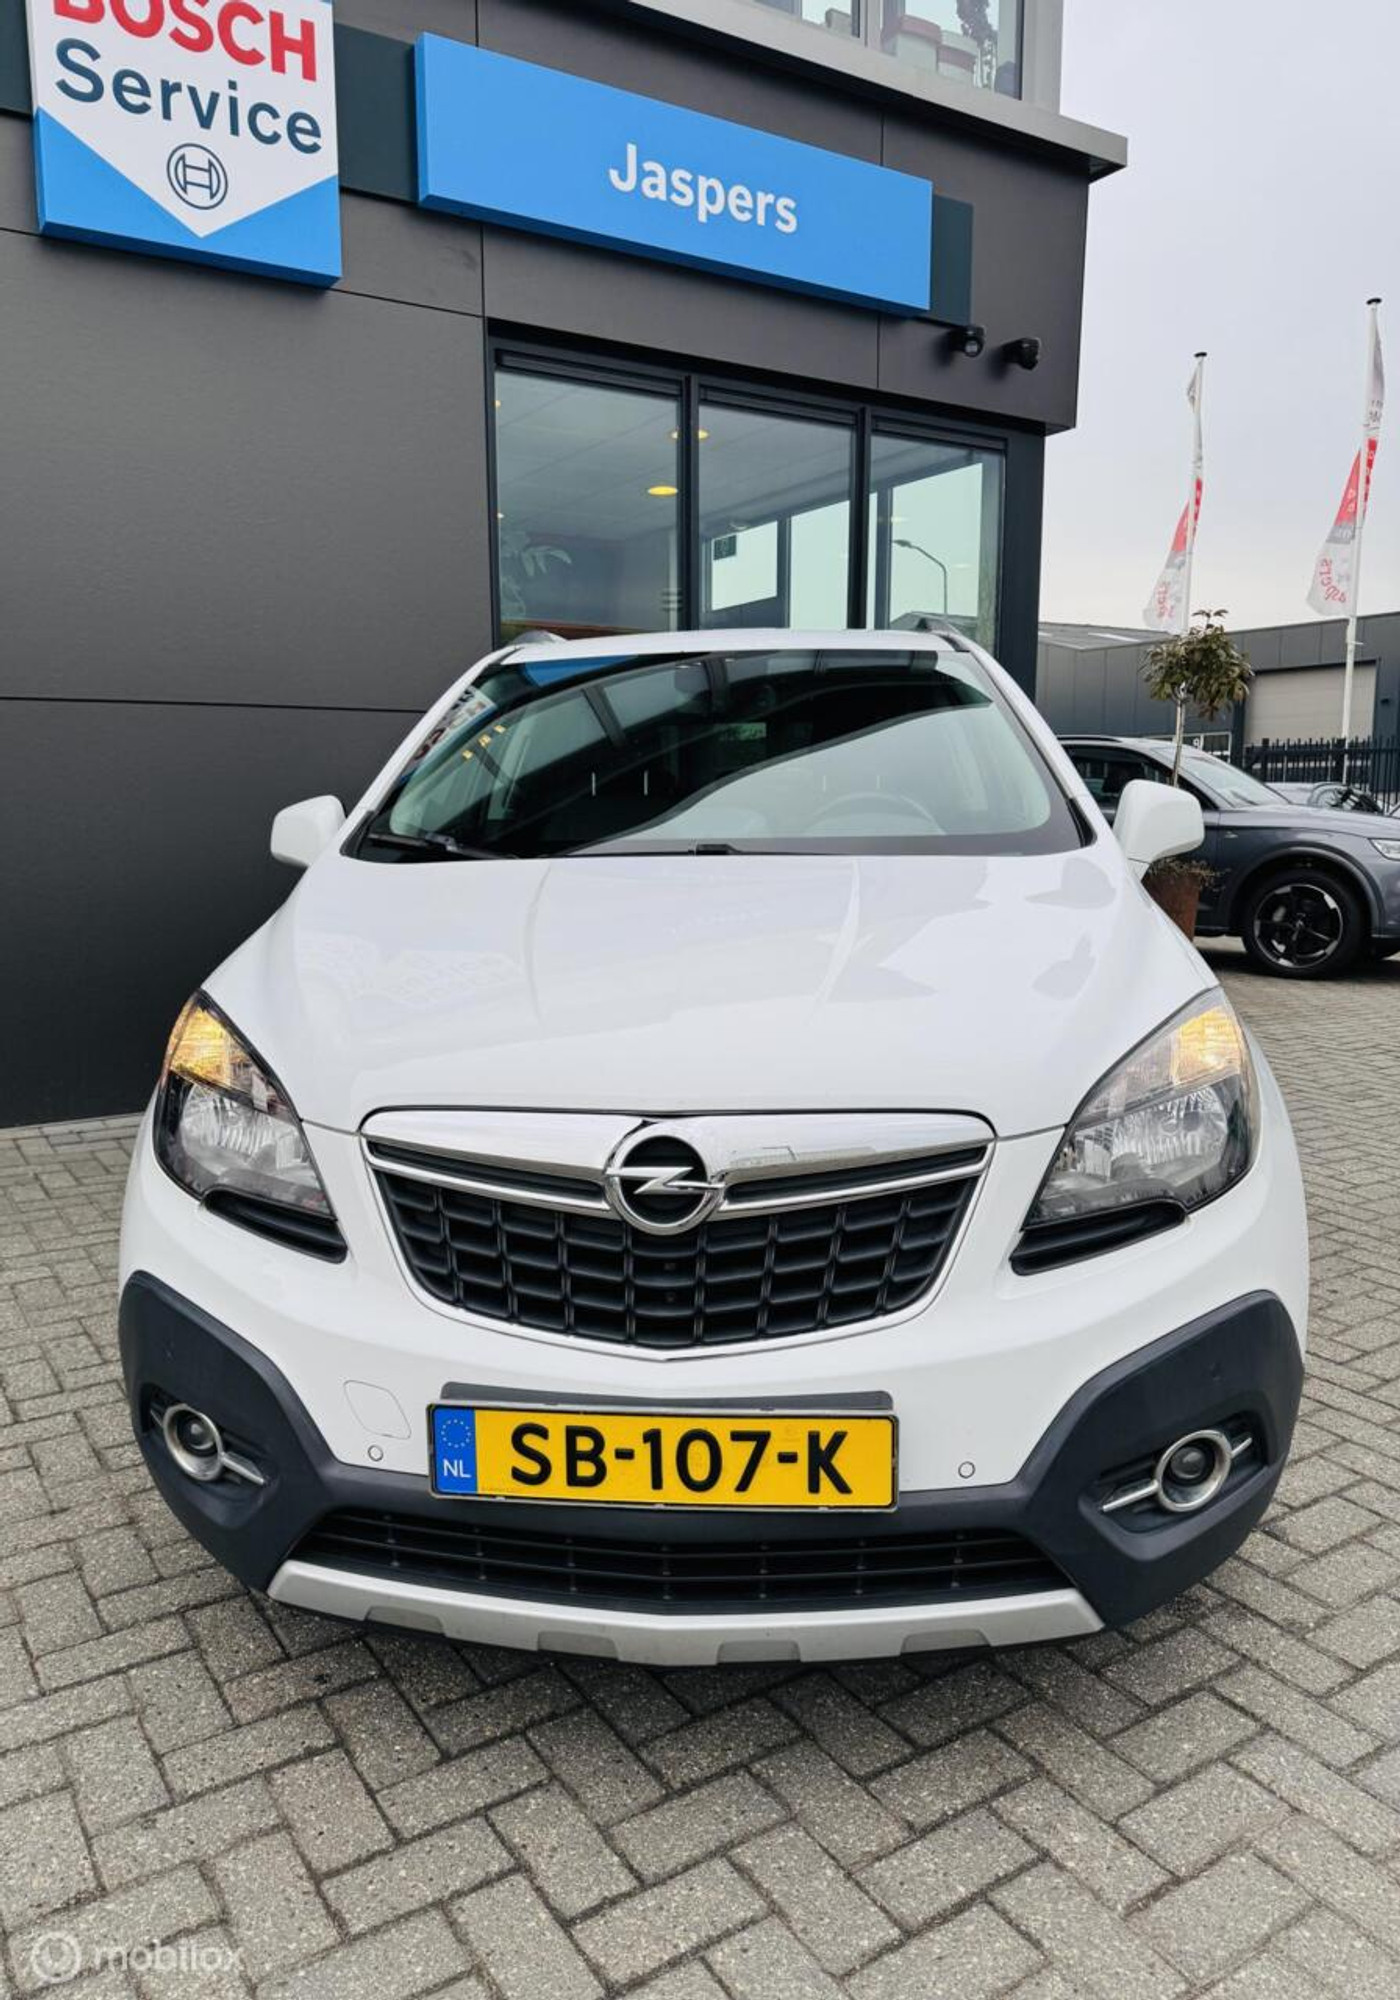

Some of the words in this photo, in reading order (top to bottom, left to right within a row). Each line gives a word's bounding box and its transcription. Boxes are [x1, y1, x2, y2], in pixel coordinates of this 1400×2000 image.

[55, 38, 322, 154] Service
[609, 142, 798, 233] Jaspers
[443, 1458, 471, 1477] NL
[510, 1422, 853, 1494] SB-107-K
